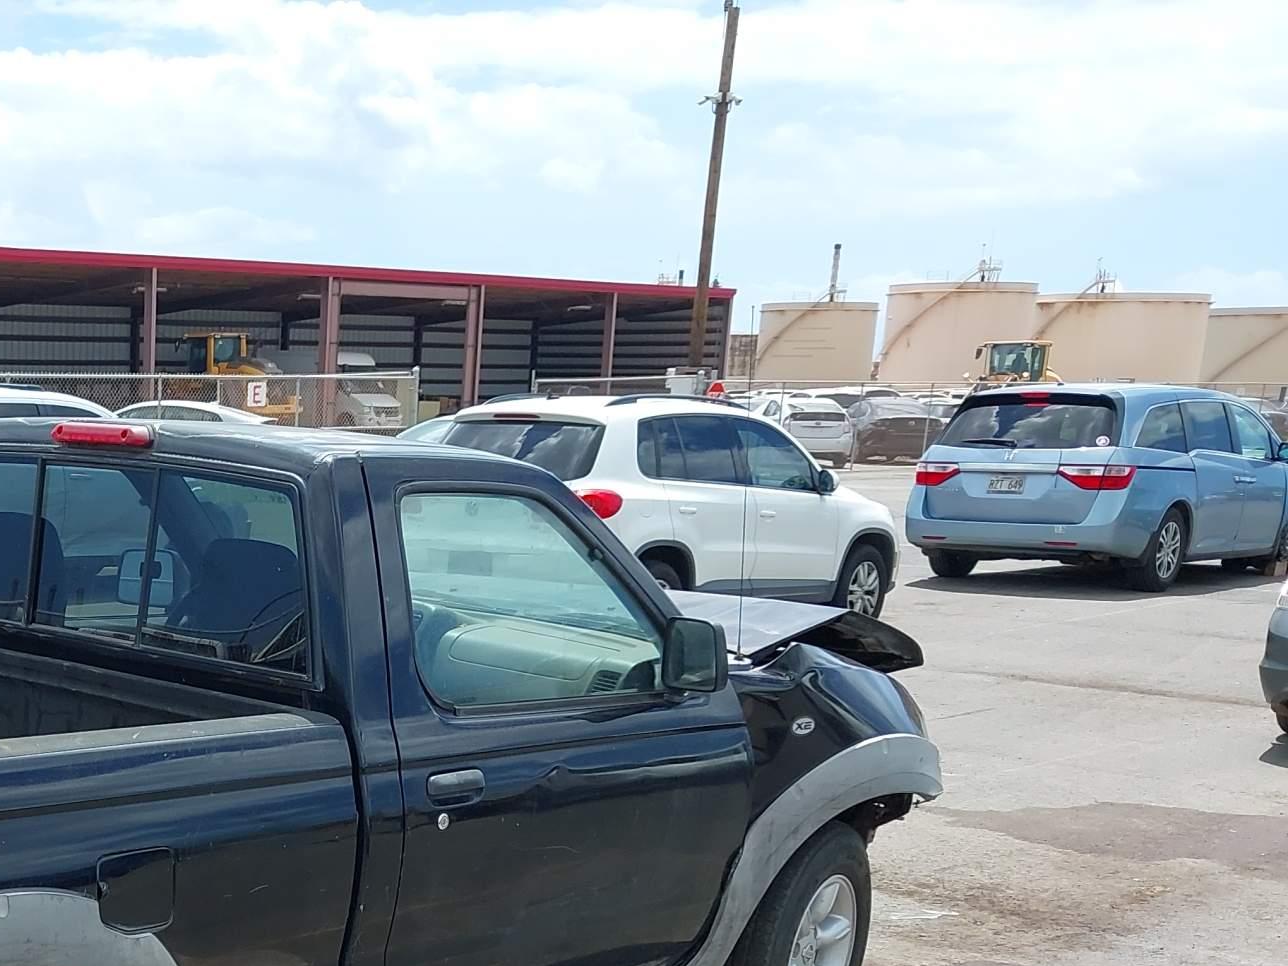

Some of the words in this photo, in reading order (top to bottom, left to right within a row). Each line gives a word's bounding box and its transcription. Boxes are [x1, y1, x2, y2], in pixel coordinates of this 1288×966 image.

[253, 385, 262, 403] E
[1008, 479, 1023, 489] 649
[795, 721, 813, 731] XE
